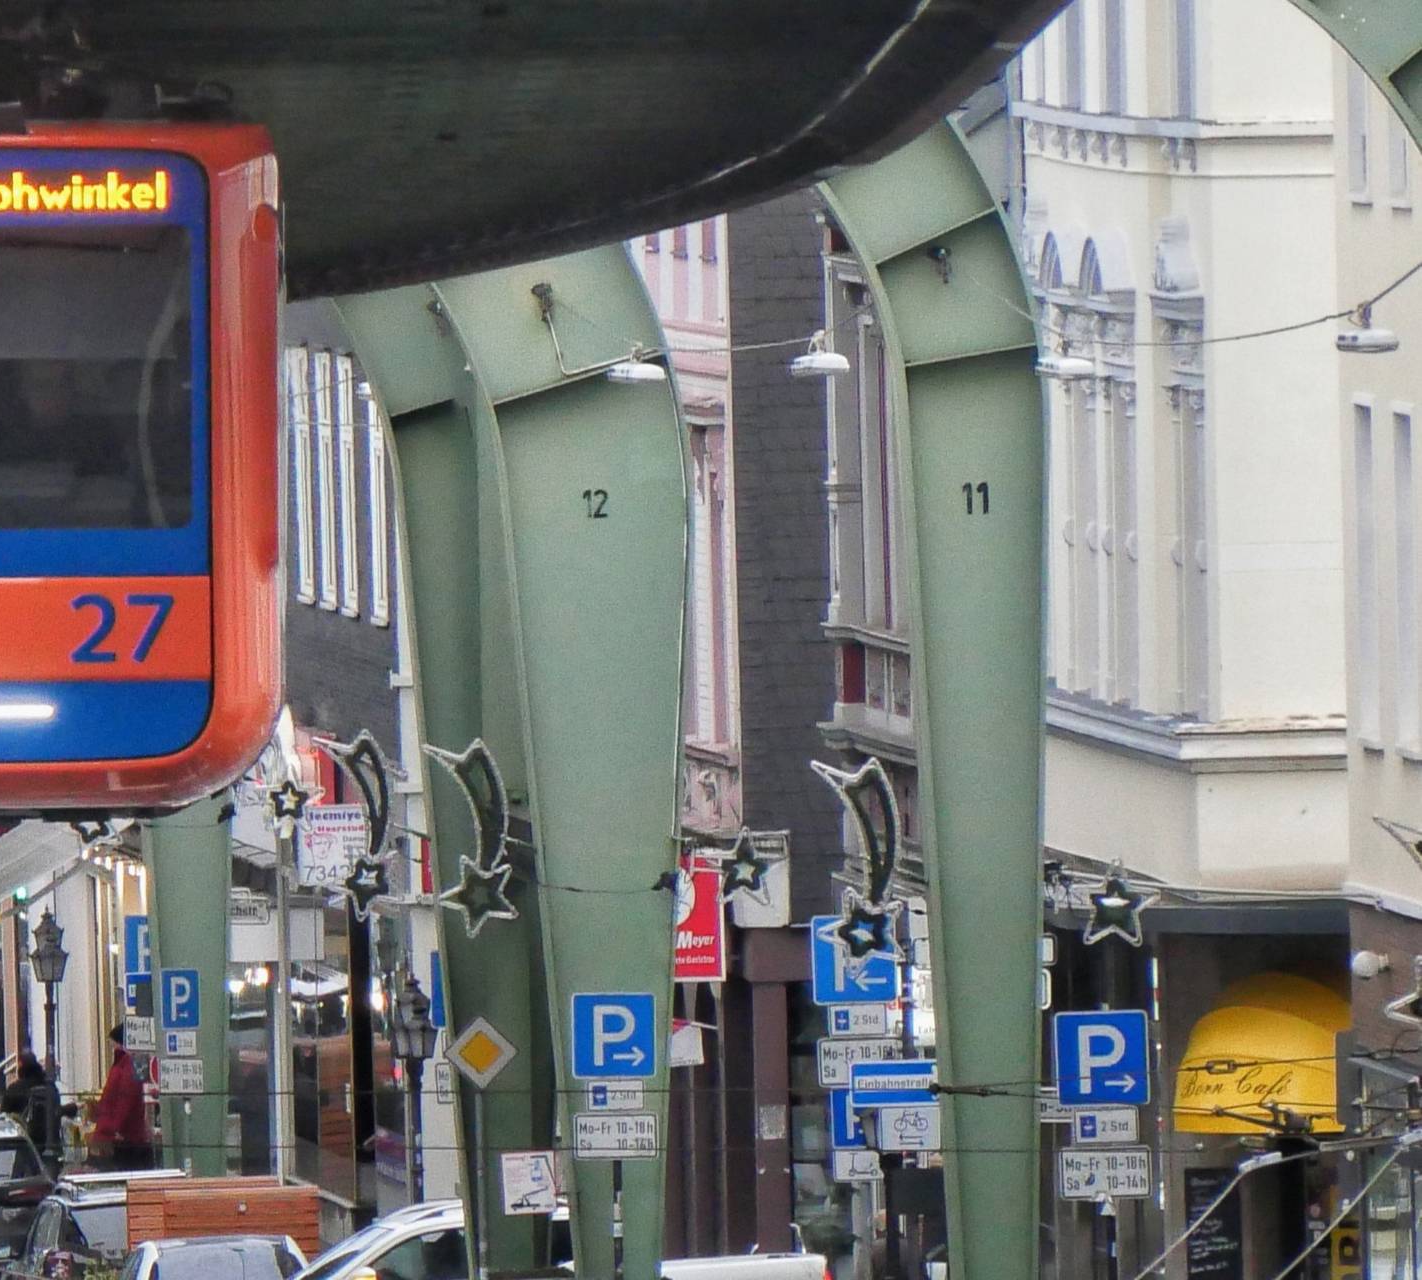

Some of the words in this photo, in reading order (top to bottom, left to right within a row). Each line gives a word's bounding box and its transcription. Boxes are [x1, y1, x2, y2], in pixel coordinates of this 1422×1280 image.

[582, 489, 609, 519] 12
[962, 481, 990, 515] 11
[70, 594, 175, 663] 27
[170, 976, 191, 1022] P
[593, 1005, 636, 1068] P
[823, 1046, 855, 1061] Mo-Fr
[1077, 1026, 1126, 1095] P
[823, 1066, 836, 1078] Sa
[579, 1121, 611, 1135] Mo-Fr
[579, 1138, 593, 1150] Sa
[1065, 1156, 1101, 1172] Mo-Fr
[1066, 1176, 1081, 1191] Sa
